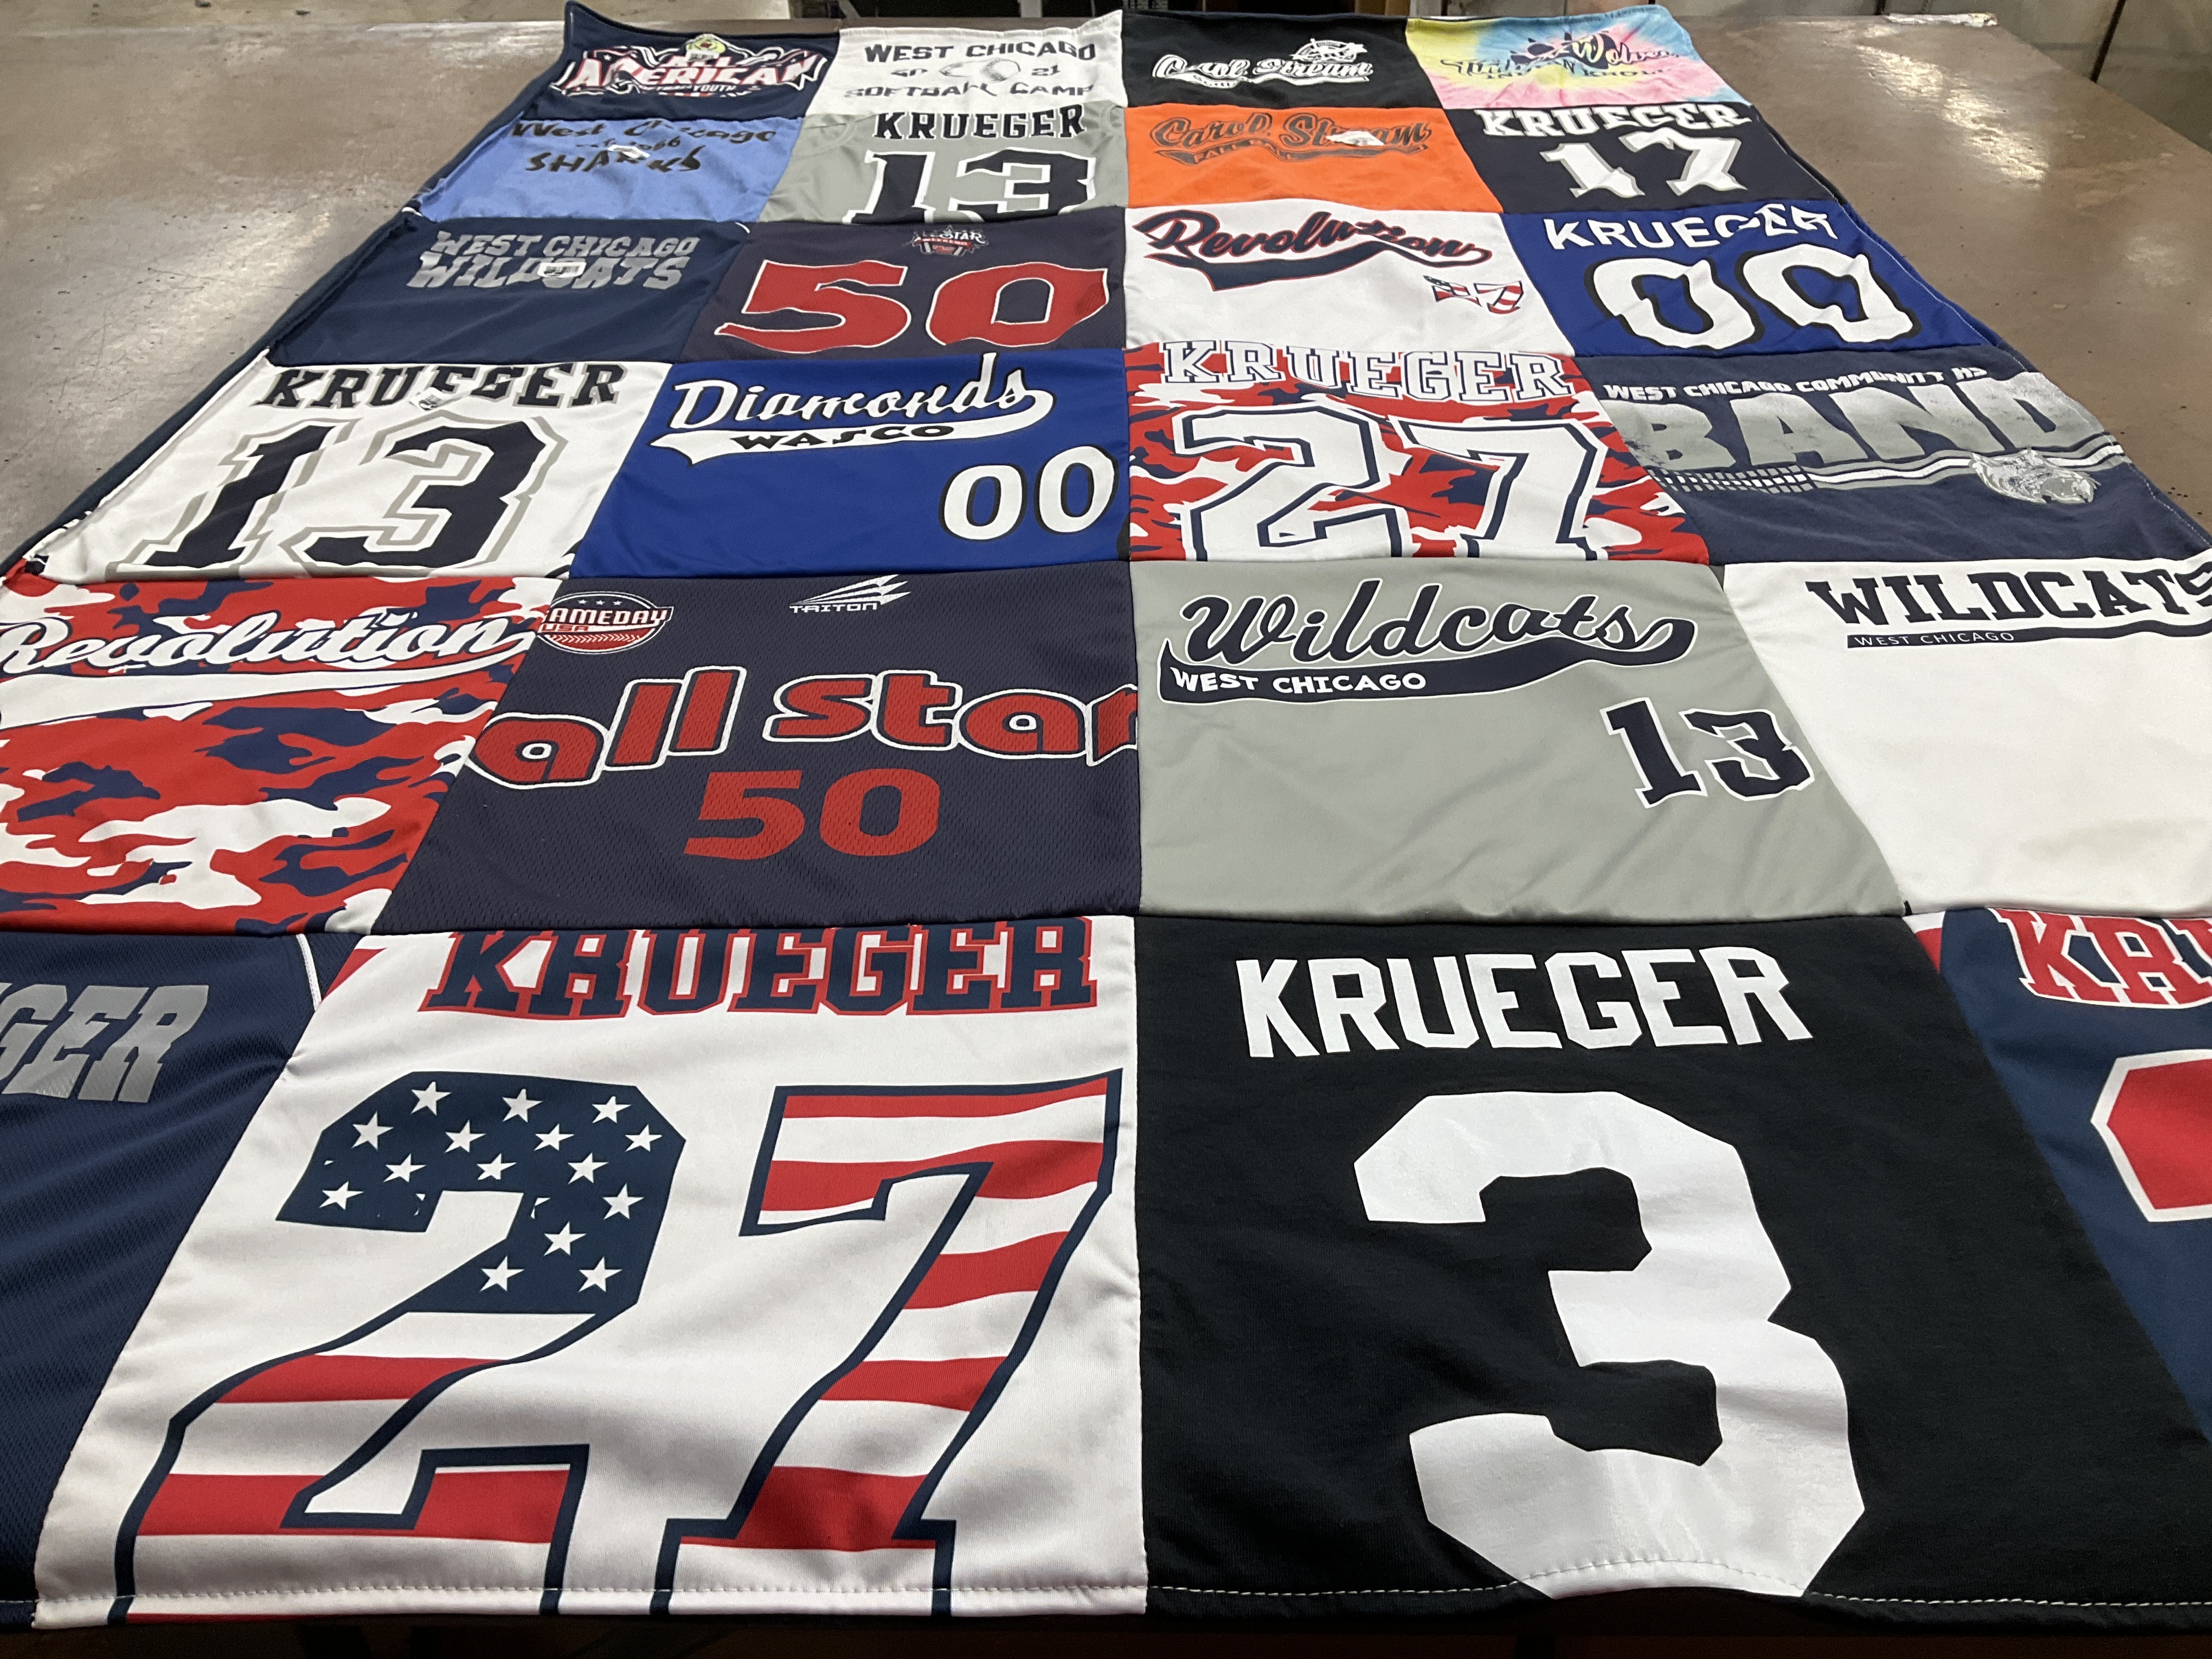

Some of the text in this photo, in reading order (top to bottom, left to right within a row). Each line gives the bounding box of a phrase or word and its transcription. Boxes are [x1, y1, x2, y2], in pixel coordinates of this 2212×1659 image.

[865, 41, 1096, 63] WEST CHICAGO
[1031, 65, 1060, 76] 21
[1153, 54, 1251, 78] Crol
[872, 104, 1086, 139] KRUEGER
[1009, 82, 1094, 97] CAMP
[1474, 103, 1752, 137] KRUEGER
[623, 120, 776, 144] Chcago
[1150, 112, 1432, 148] Carol Stam
[842, 146, 1096, 224] 13
[1540, 128, 1748, 198] 17
[430, 230, 701, 257] WEST CHICAGO
[1543, 204, 1837, 250] KRUEGER
[714, 259, 1110, 354] 50
[249, 362, 629, 409] KRUEGER
[668, 352, 1032, 430] Diamonds
[1158, 339, 1576, 403] KRUEGER
[1603, 385, 1676, 400] WEST
[1683, 381, 1792, 397] CHICAGO
[1796, 370, 1945, 392] COMMUNITY
[730, 424, 955, 450] WASCO
[1600, 371, 2106, 472] BAND
[111, 410, 569, 576] 13
[938, 444, 1119, 541] 00
[1171, 403, 1610, 562] 27
[543, 607, 668, 627] AMEDAY
[789, 603, 877, 614] TRITON
[1179, 578, 1638, 665] Wildcats
[1854, 632, 2015, 646] WEST CHICAGO
[0, 611, 536, 675] Revolution
[1172, 667, 1427, 694] WEST CHICAGO
[469, 665, 1138, 789] all star
[1599, 697, 1815, 808] 13
[684, 768, 940, 860] 50
[421, 927, 1099, 1020] KRUEGER
[1987, 908, 2212, 1009] KR
[1235, 946, 1813, 1059] KRUEGER
[0, 982, 209, 1103] GER
[107, 1068, 1124, 1625] 27
[1353, 1091, 1865, 1599] 3
